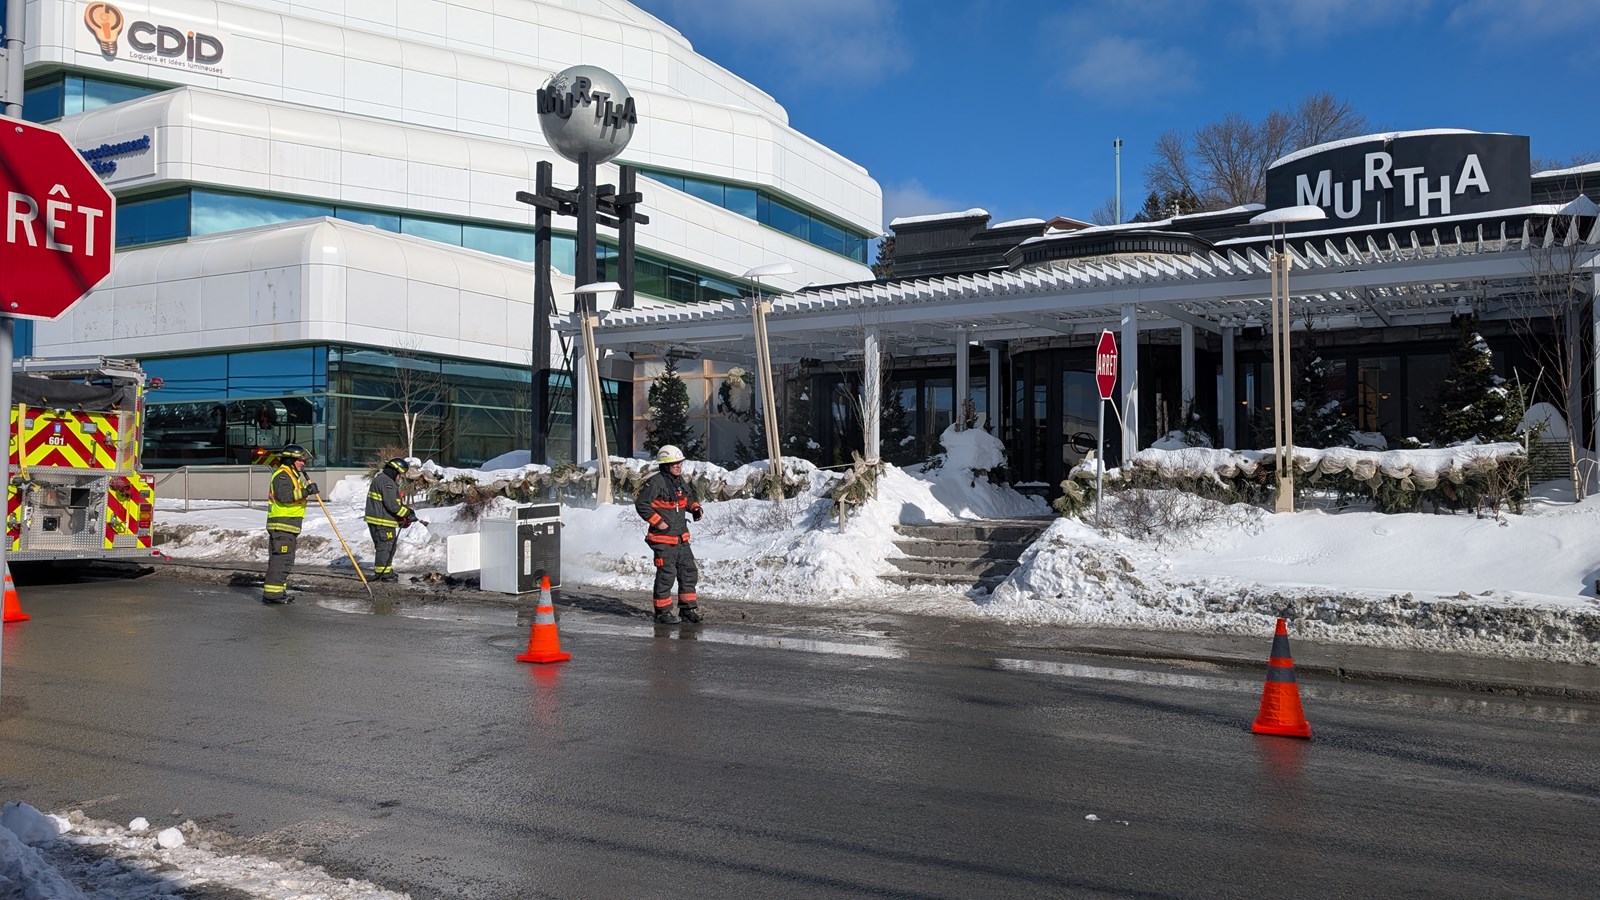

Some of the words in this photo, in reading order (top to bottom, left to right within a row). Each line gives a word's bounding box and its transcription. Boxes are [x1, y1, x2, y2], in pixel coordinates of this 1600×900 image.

[129, 51, 158, 61] Logiciels
[159, 56, 167, 64] et
[187, 62, 223, 74] lumineuses
[536, 76, 638, 129] MURTHA
[1295, 151, 1491, 219] MURTHA
[6, 183, 104, 257] RÊT
[1097, 349, 1117, 376] ARRÊT
[48, 436, 64, 445] 601
